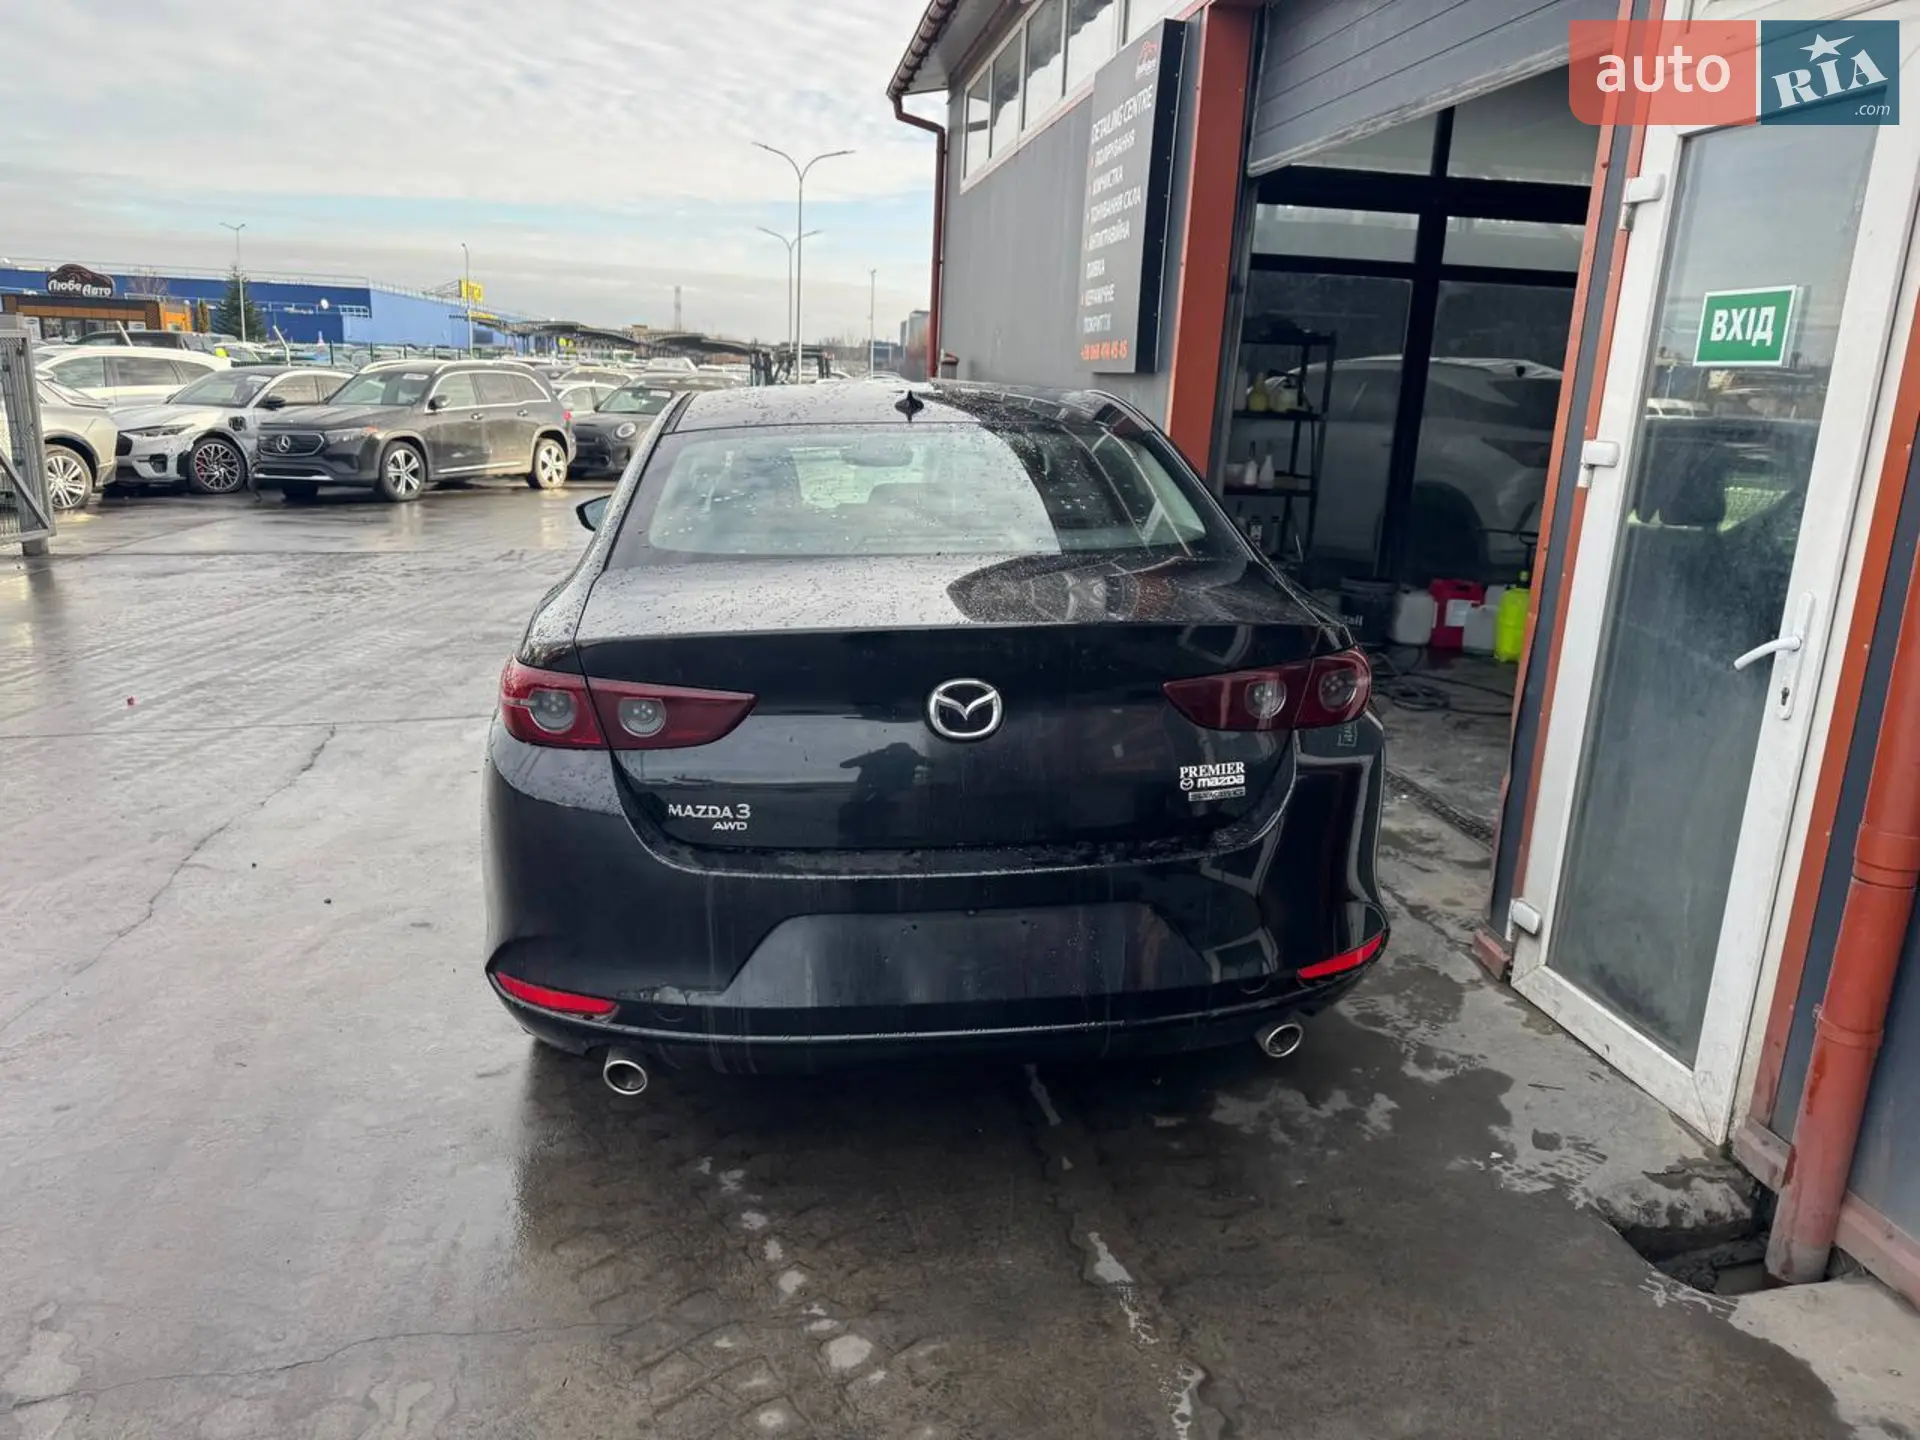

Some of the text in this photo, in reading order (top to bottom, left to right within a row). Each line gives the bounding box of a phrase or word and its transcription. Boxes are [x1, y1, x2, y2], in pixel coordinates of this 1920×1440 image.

[1091, 83, 1155, 145] DETAILING CENTRE
[1710, 305, 1776, 347] ВХІД
[1179, 761, 1245, 778] PREMIER
[668, 803, 751, 819] MAZDA 3
[711, 821, 748, 831] AWD
